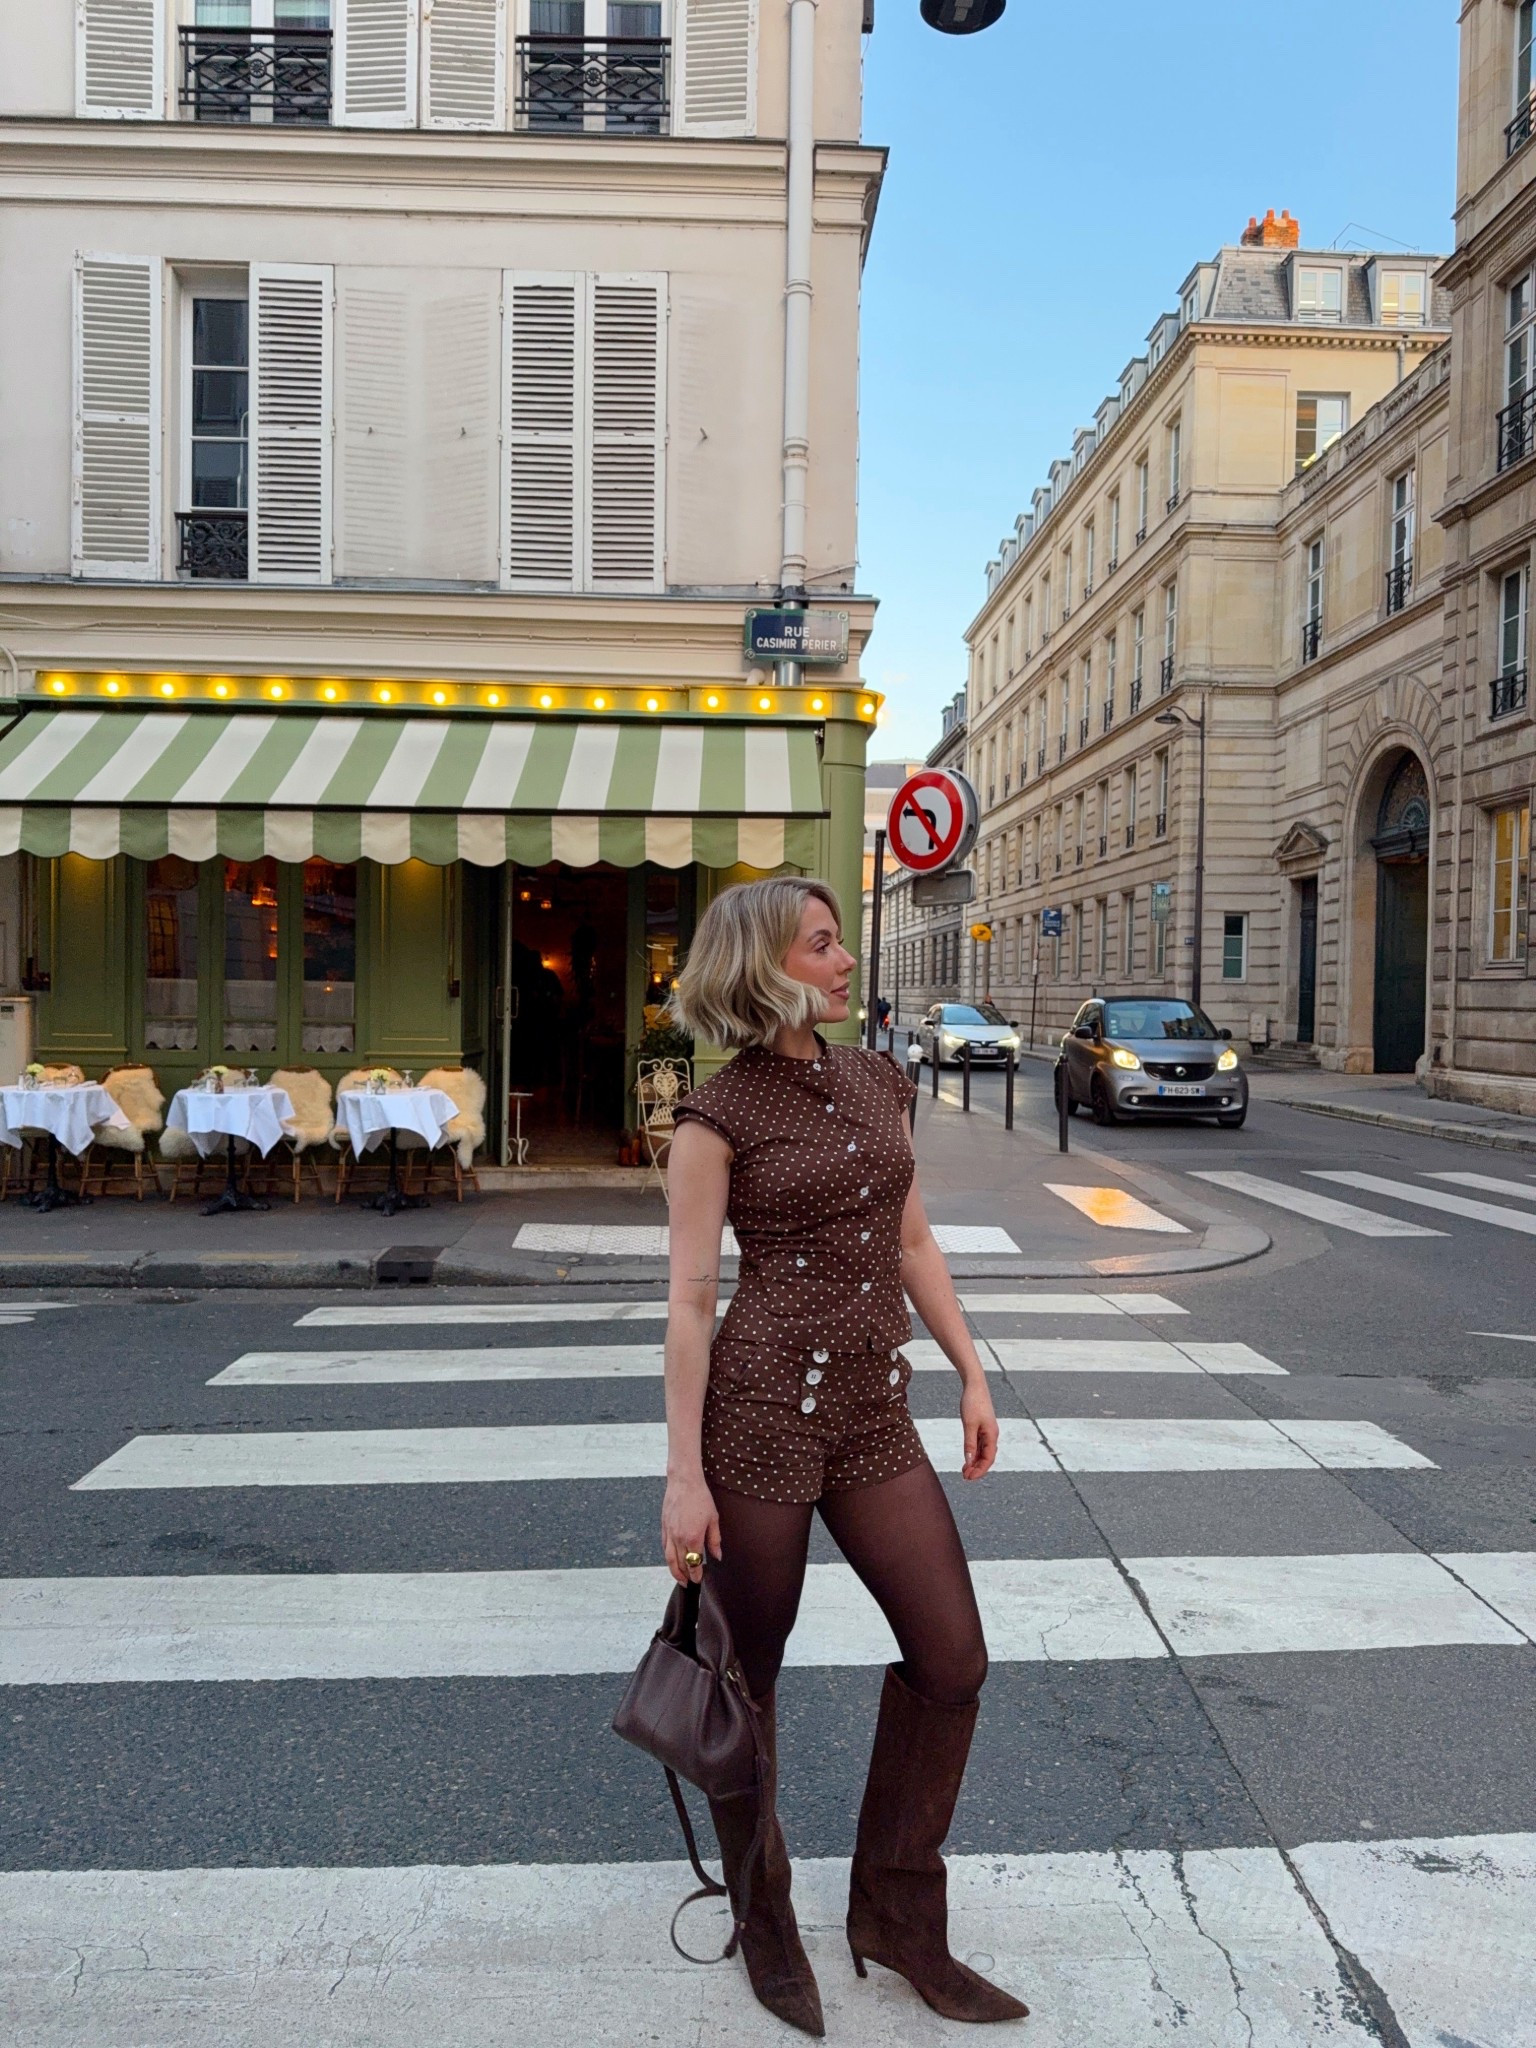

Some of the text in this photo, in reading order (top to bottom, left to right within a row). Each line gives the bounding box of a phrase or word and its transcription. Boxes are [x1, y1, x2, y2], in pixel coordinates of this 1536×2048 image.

[784, 626, 810, 637] RUE
[756, 637, 837, 650] CASIMIR PERIER
